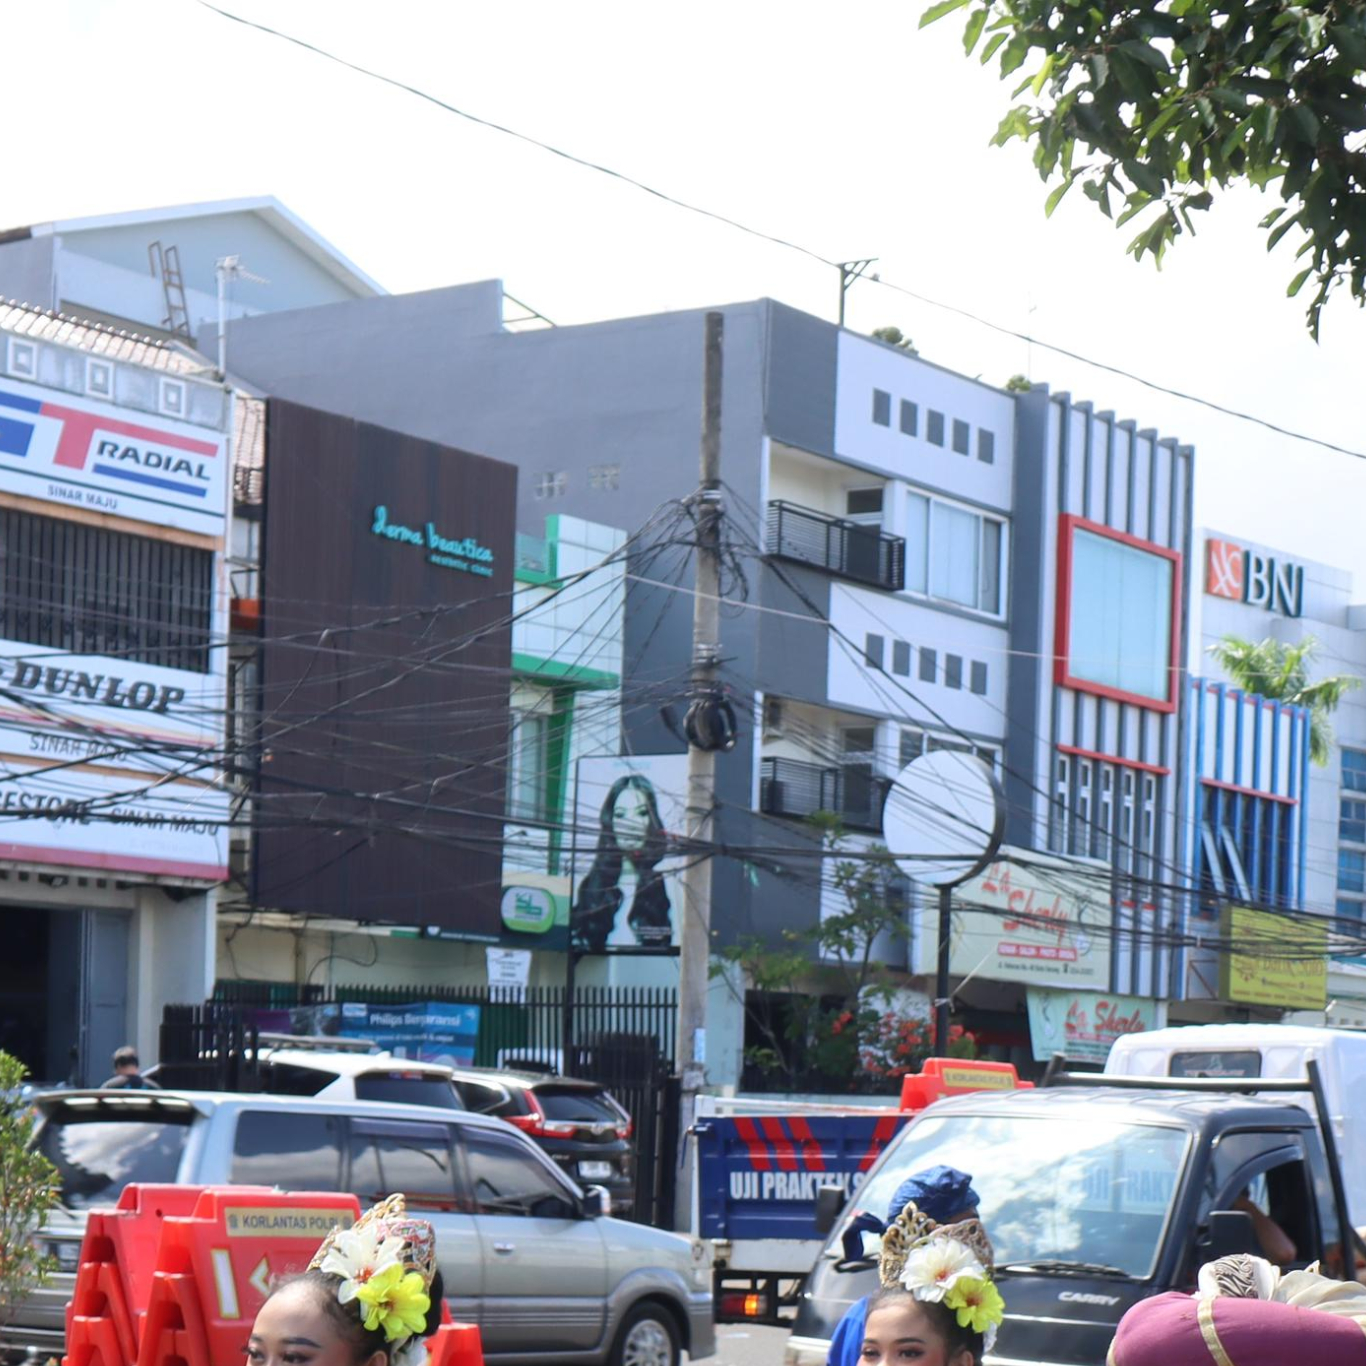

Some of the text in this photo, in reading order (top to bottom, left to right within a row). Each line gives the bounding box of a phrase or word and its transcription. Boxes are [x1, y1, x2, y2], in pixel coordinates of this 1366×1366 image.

[96, 440, 212, 481] RADIAL
[47, 484, 119, 509] SINAR MAJU
[371, 505, 494, 562] derma beautica
[9, 660, 185, 713] DUNLOP
[29, 734, 128, 762] SINAR MAJU
[172, 814, 221, 837] MAJU
[730, 1171, 760, 1200] UJI
[242, 1214, 306, 1229] KORLANTAS
[1058, 1291, 1121, 1306] CARRY
